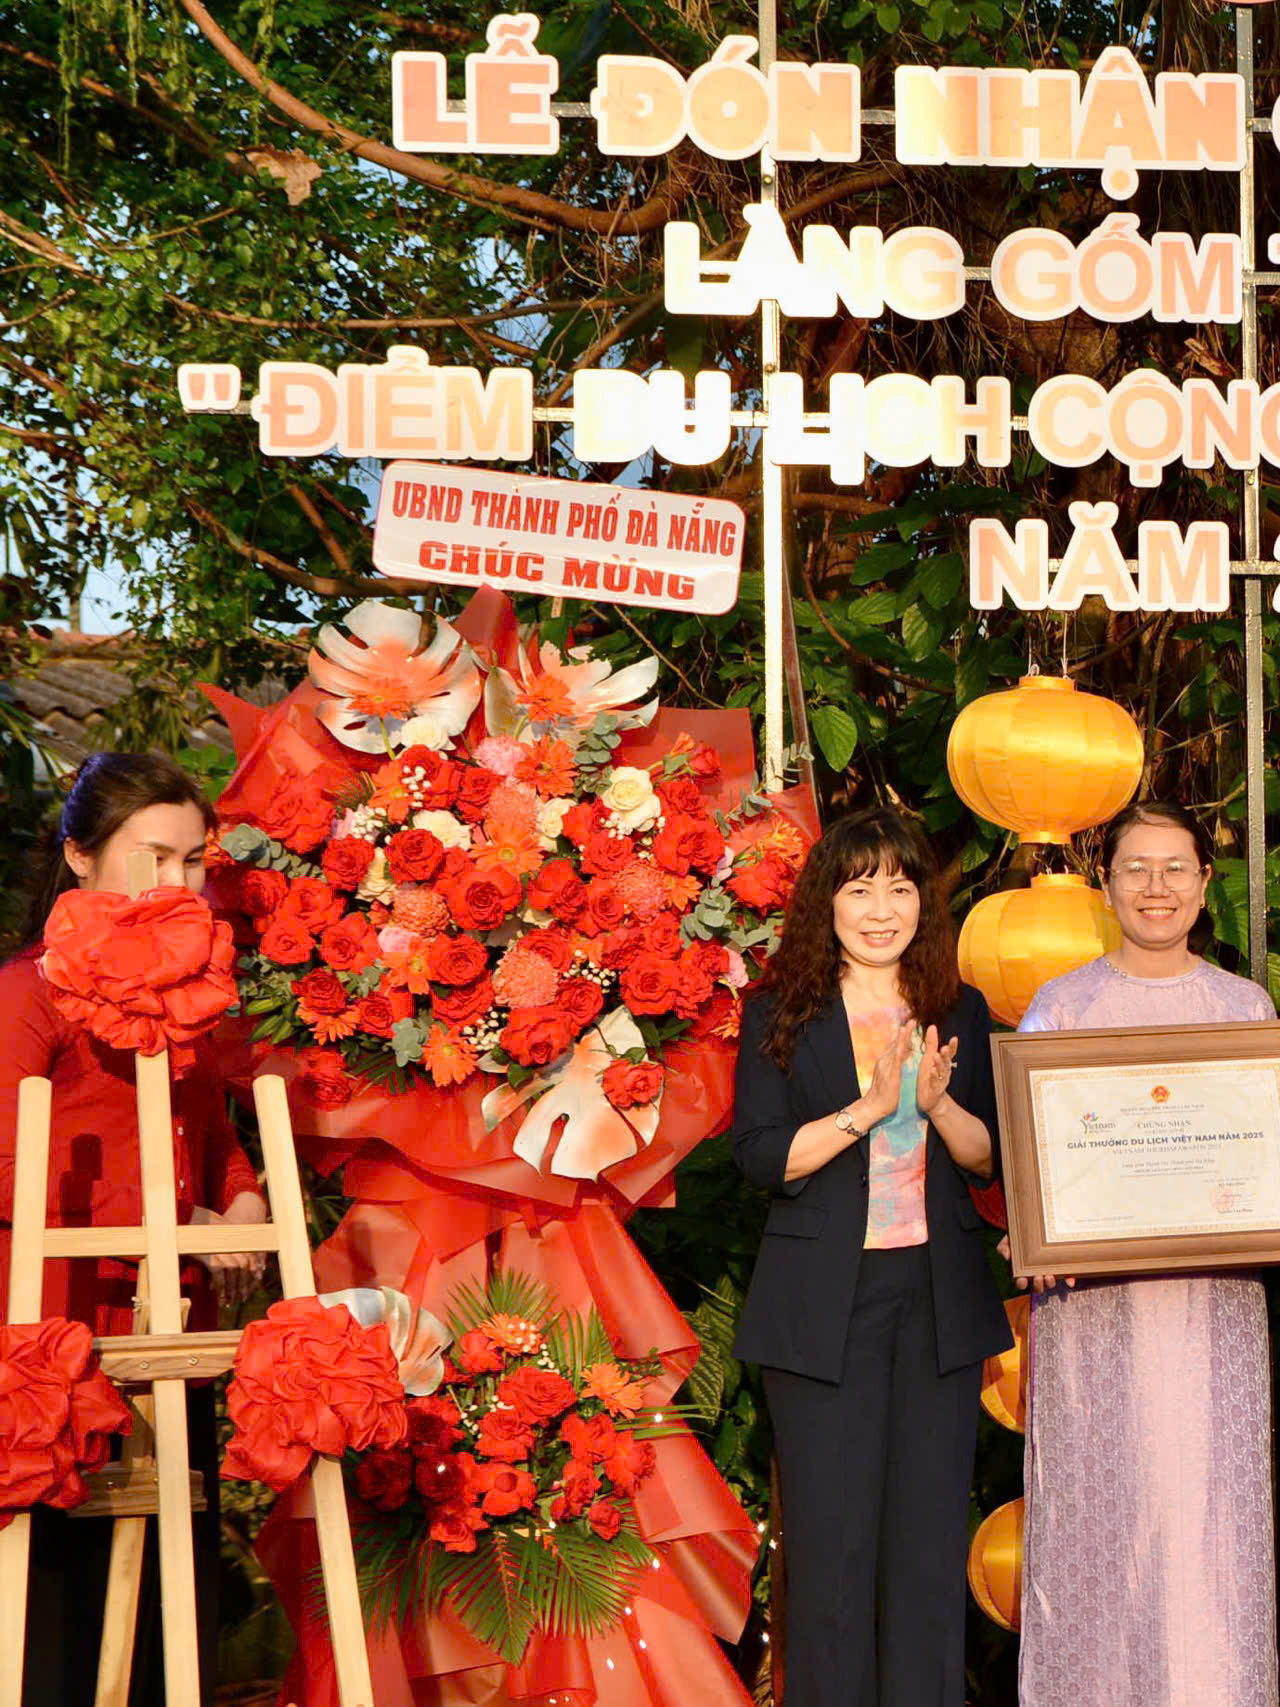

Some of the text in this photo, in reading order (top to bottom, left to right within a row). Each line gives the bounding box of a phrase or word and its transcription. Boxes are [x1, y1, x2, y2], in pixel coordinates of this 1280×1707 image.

[393, 13, 560, 154] LỄ
[591, 34, 861, 162] ĐÓN
[895, 46, 1247, 200] NHẬN
[664, 204, 965, 320] LÀNG
[991, 212, 1244, 323] GỐM
[573, 368, 732, 466] DU
[769, 372, 1011, 486] LỊCH
[392, 481, 737, 557] UBND THÀNH PHỐ ĐÀ NẴNG
[419, 541, 696, 601] CHÚC MỪNG
[969, 501, 1229, 612] NĂM
[1131, 1136, 1145, 1147] DU
[1195, 1133, 1217, 1143] NAM
[1242, 1130, 1265, 1141] 2025
